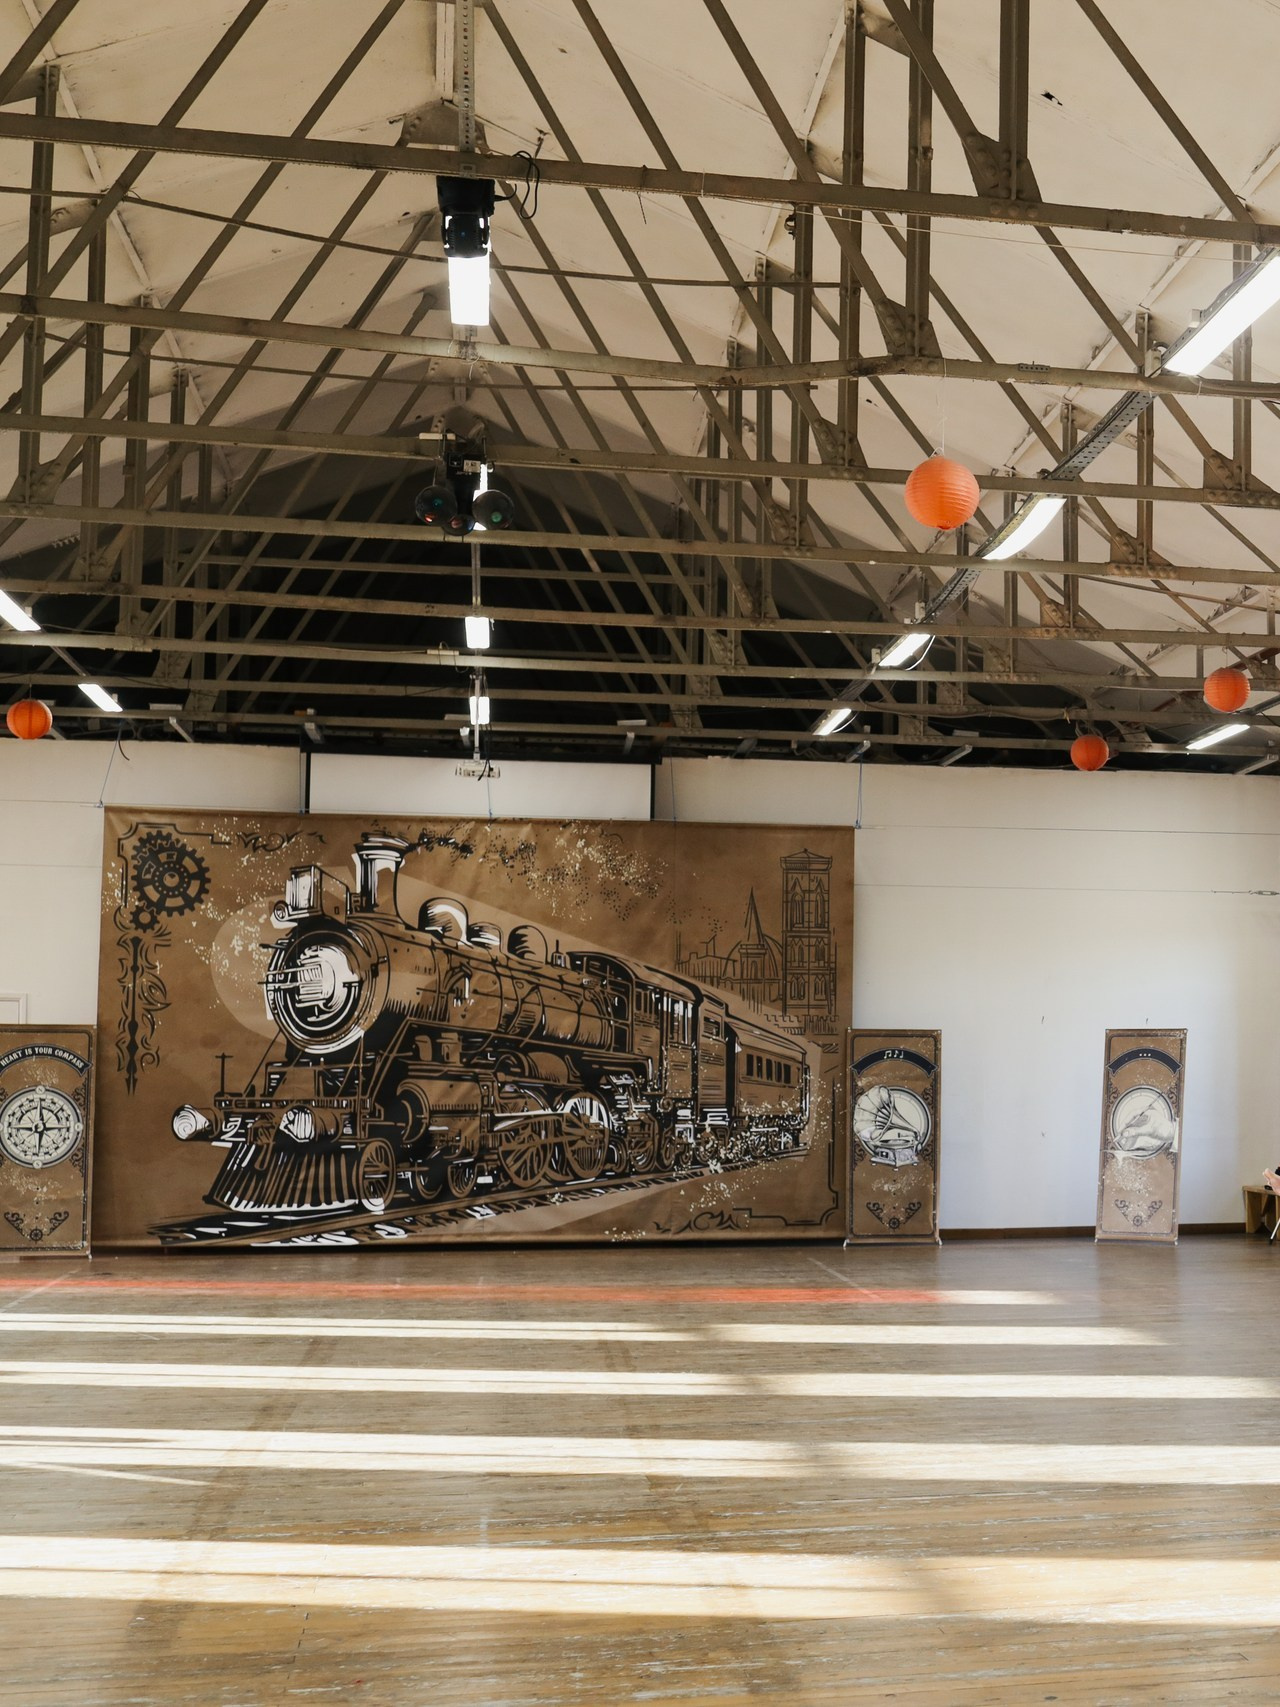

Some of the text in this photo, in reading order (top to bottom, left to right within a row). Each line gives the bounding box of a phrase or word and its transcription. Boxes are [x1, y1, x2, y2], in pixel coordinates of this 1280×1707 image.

[0, 1050, 22, 1067] HEART
[34, 1047, 53, 1055] YOUR
[54, 1049, 84, 1069] COMPASS
